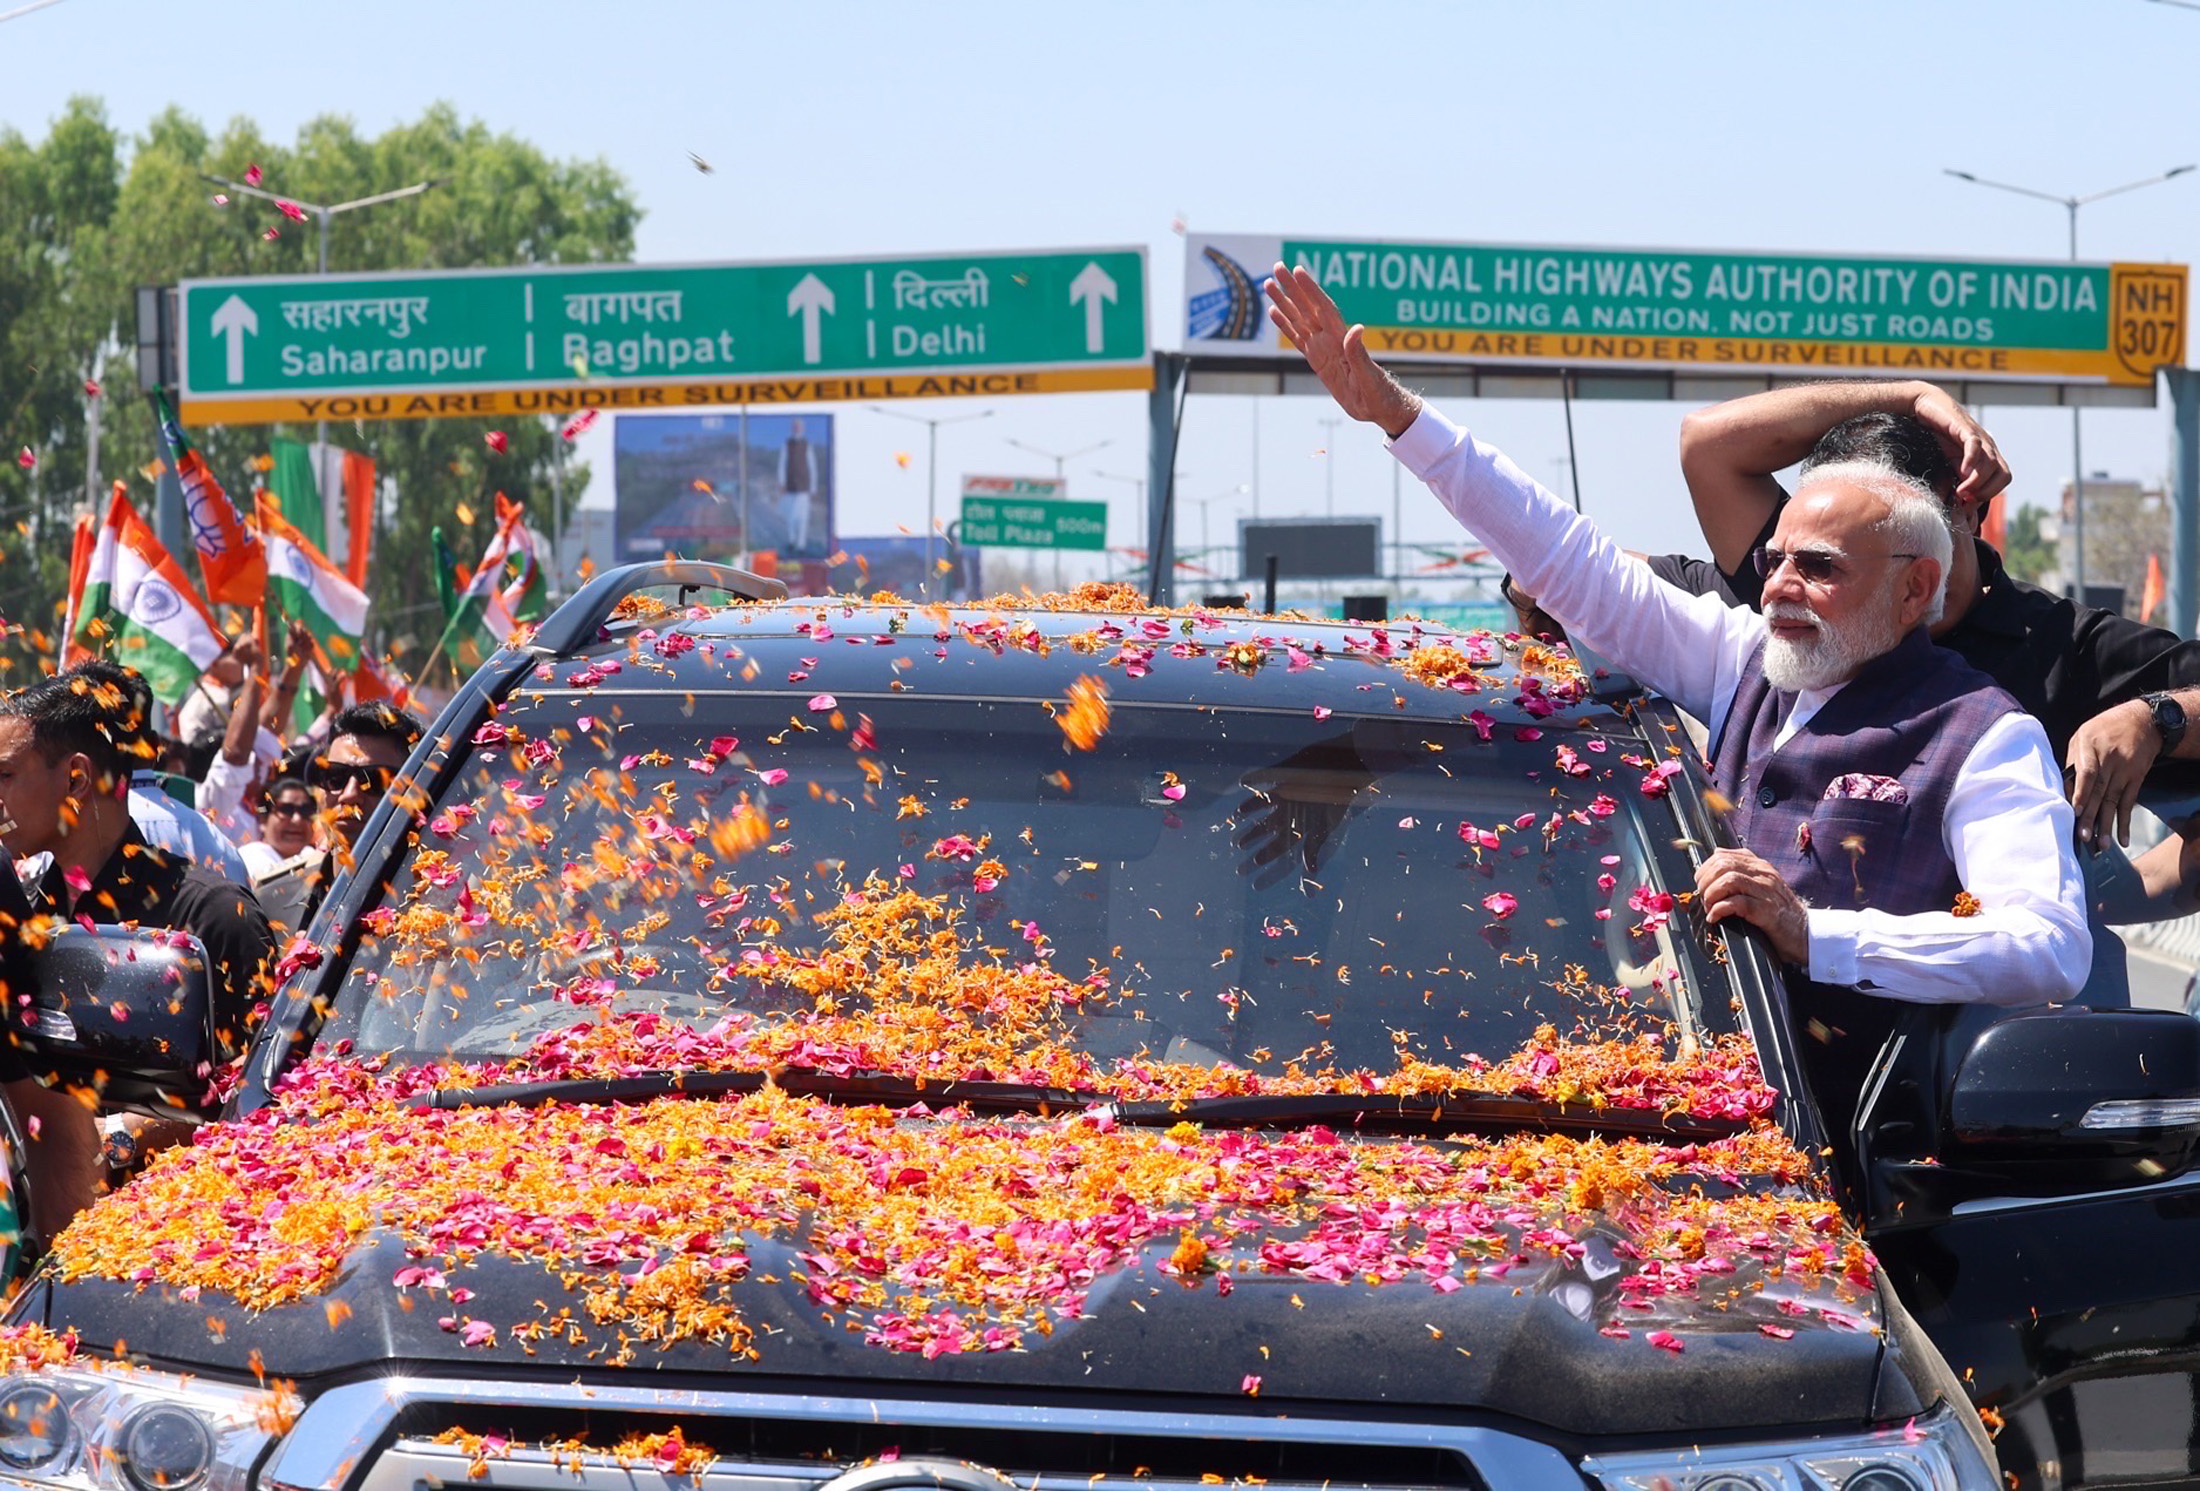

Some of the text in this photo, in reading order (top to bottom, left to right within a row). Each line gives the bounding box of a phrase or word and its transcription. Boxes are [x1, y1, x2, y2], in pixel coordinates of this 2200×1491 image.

[893, 267, 988, 308] दिल्ली
[1297, 249, 2096, 313] NATIONAL HIGHWAYS AUTHORITY OF INDIA
[2126, 282, 2173, 313] NH
[281, 298, 427, 338] सहारनपुर
[564, 291, 682, 325] बागपत
[1397, 299, 1551, 327] BUILDING
[1562, 303, 1582, 327] A
[1730, 309, 1794, 335] NOT
[1803, 313, 1877, 338] JUST
[1888, 316, 1993, 342] ROADS
[562, 331, 735, 370] Baghpat
[893, 324, 985, 357] Delhi
[1381, 331, 2009, 370] YOU ARE UNDER SURVEILLANCE
[2122, 319, 2174, 357] 307
[281, 344, 487, 375] Saharanpur
[297, 374, 1037, 417] YOU ARE UNDER SURVEILLANCE
